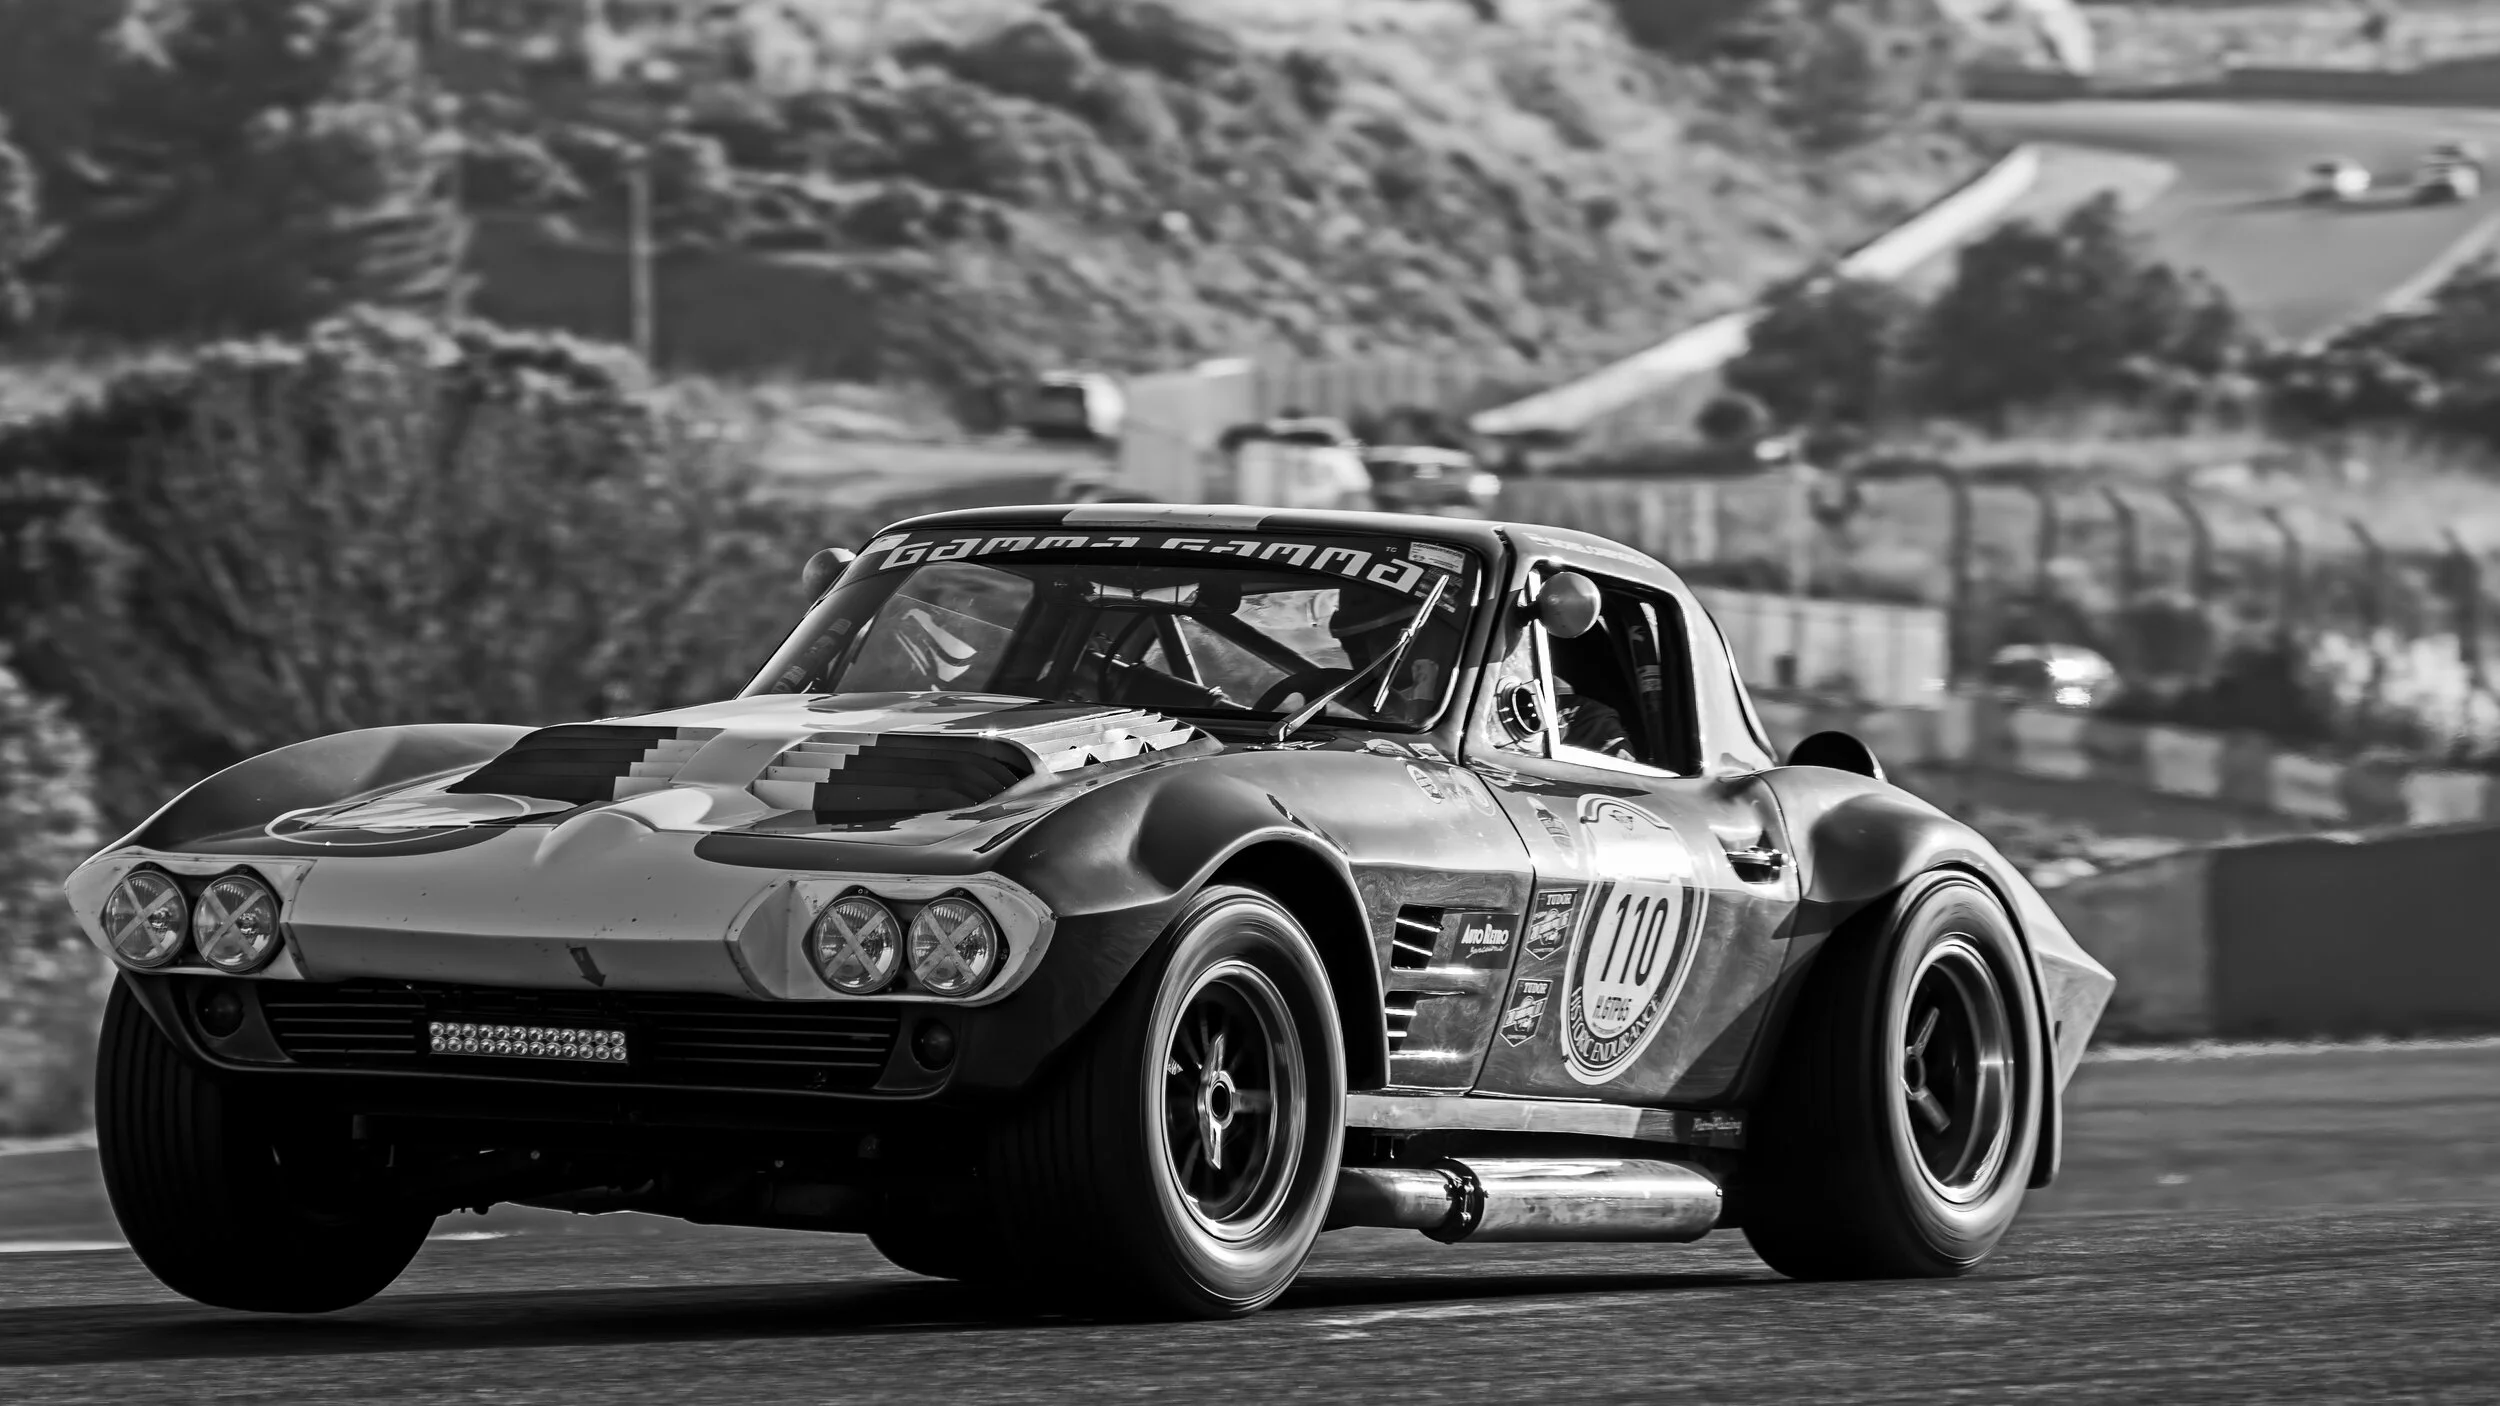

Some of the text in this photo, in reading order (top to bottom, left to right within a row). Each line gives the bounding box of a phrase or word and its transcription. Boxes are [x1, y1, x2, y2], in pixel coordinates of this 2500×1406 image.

[1547, 893, 1572, 905] TUDOR
[1600, 894, 1668, 986] 110
[1523, 982, 1548, 994] TUDOR
